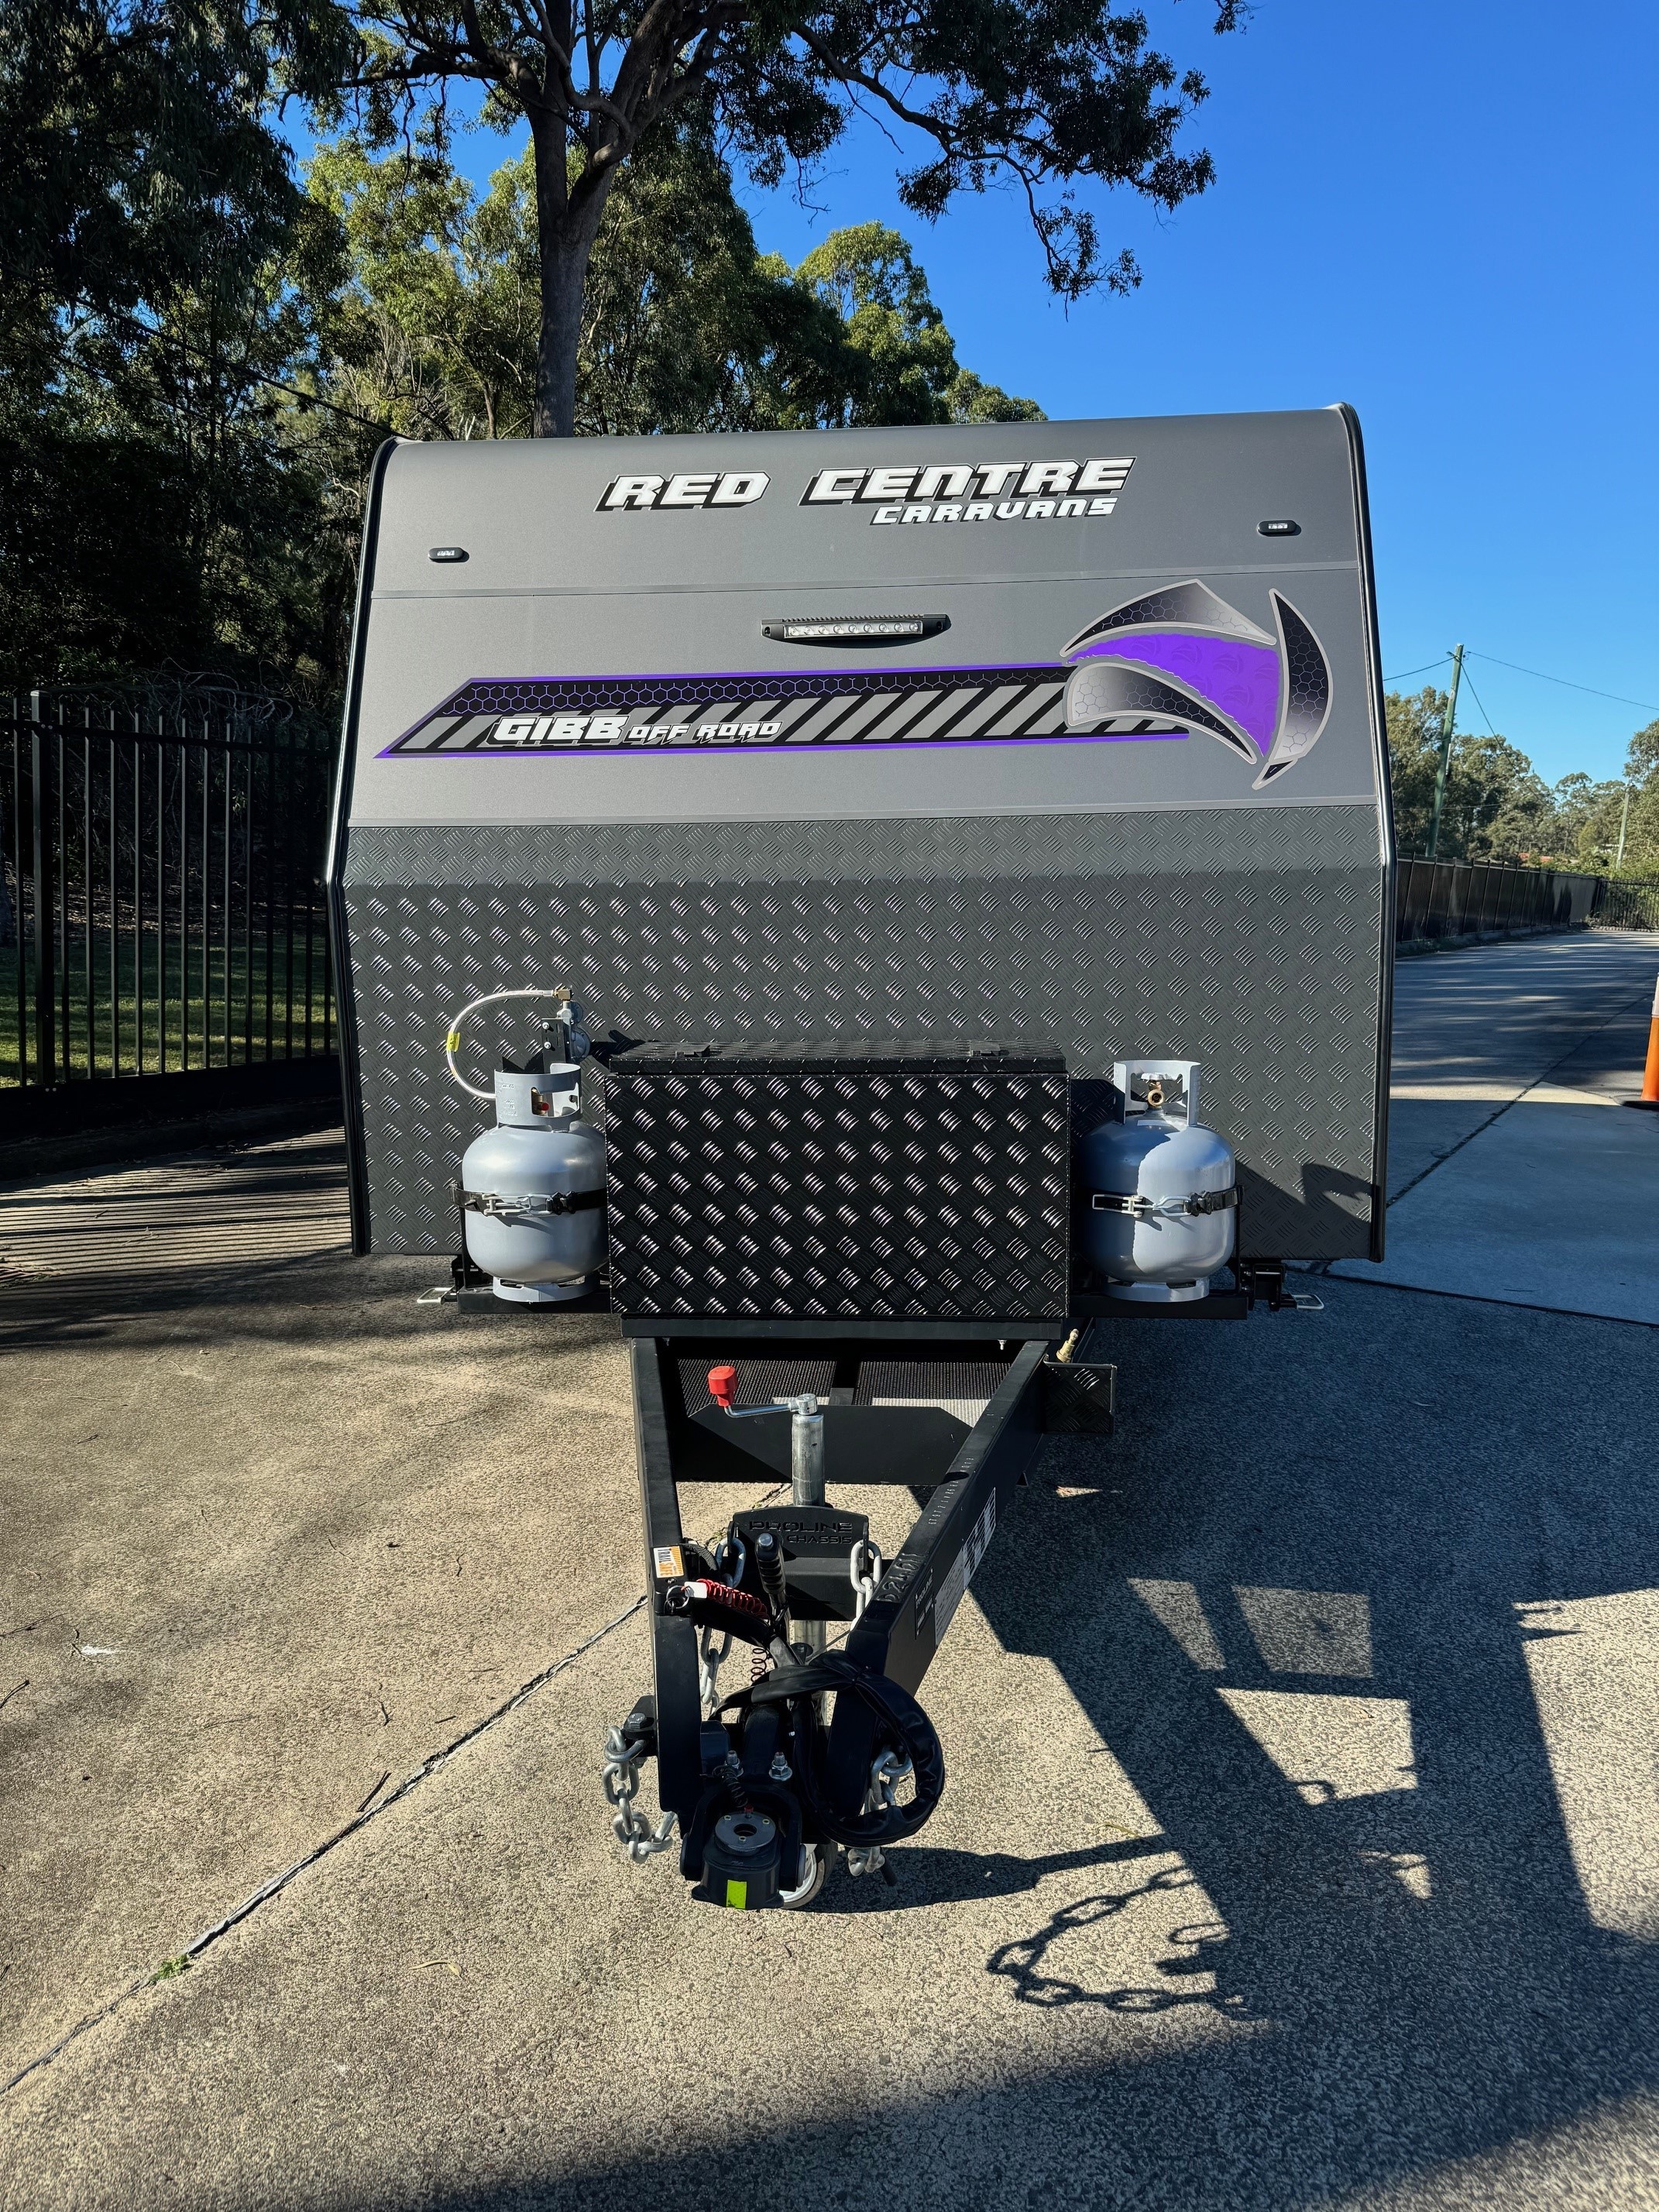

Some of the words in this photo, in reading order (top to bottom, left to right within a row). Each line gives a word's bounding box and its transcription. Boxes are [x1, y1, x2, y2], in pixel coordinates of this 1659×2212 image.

[596, 471, 771, 511] RED
[800, 457, 1136, 506] CENTRE
[871, 497, 1118, 525] CARAVANS
[490, 716, 629, 744] GIBB
[626, 723, 690, 743] OFF
[696, 721, 782, 743] ROAD
[749, 1520, 853, 1534] PROLINE
[786, 1535, 853, 1545] CHASSIS
